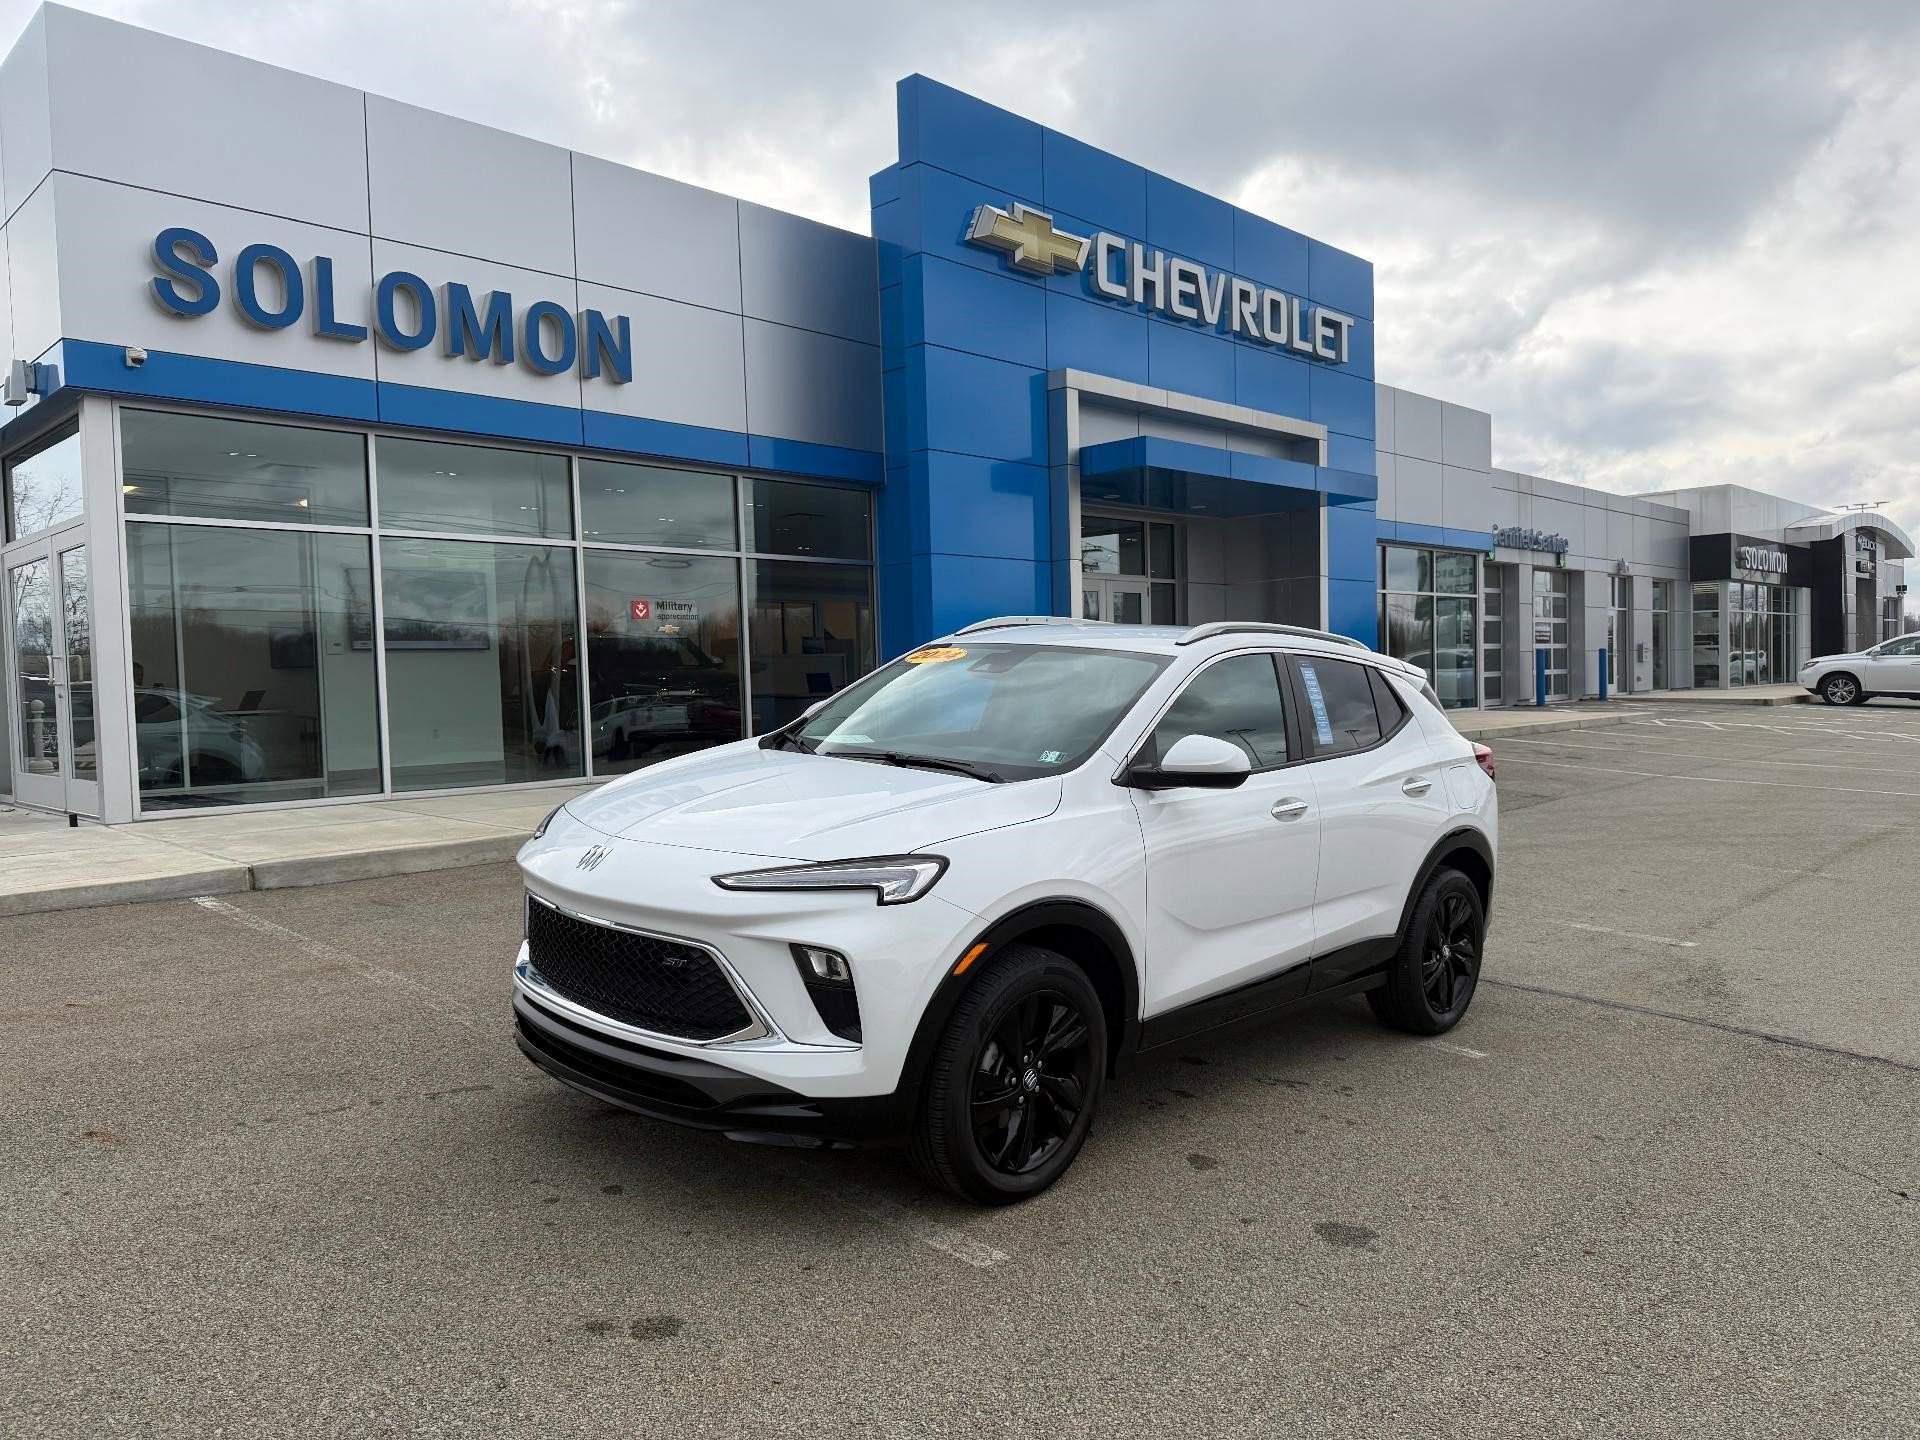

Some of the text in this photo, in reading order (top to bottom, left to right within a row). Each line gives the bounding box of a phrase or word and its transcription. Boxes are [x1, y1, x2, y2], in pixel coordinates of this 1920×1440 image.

[149, 227, 633, 384] SOLOMON
[1092, 231, 1355, 363] CHEVROLET
[1744, 546, 1788, 573] SOLOMON
[656, 601, 693, 612] Military
